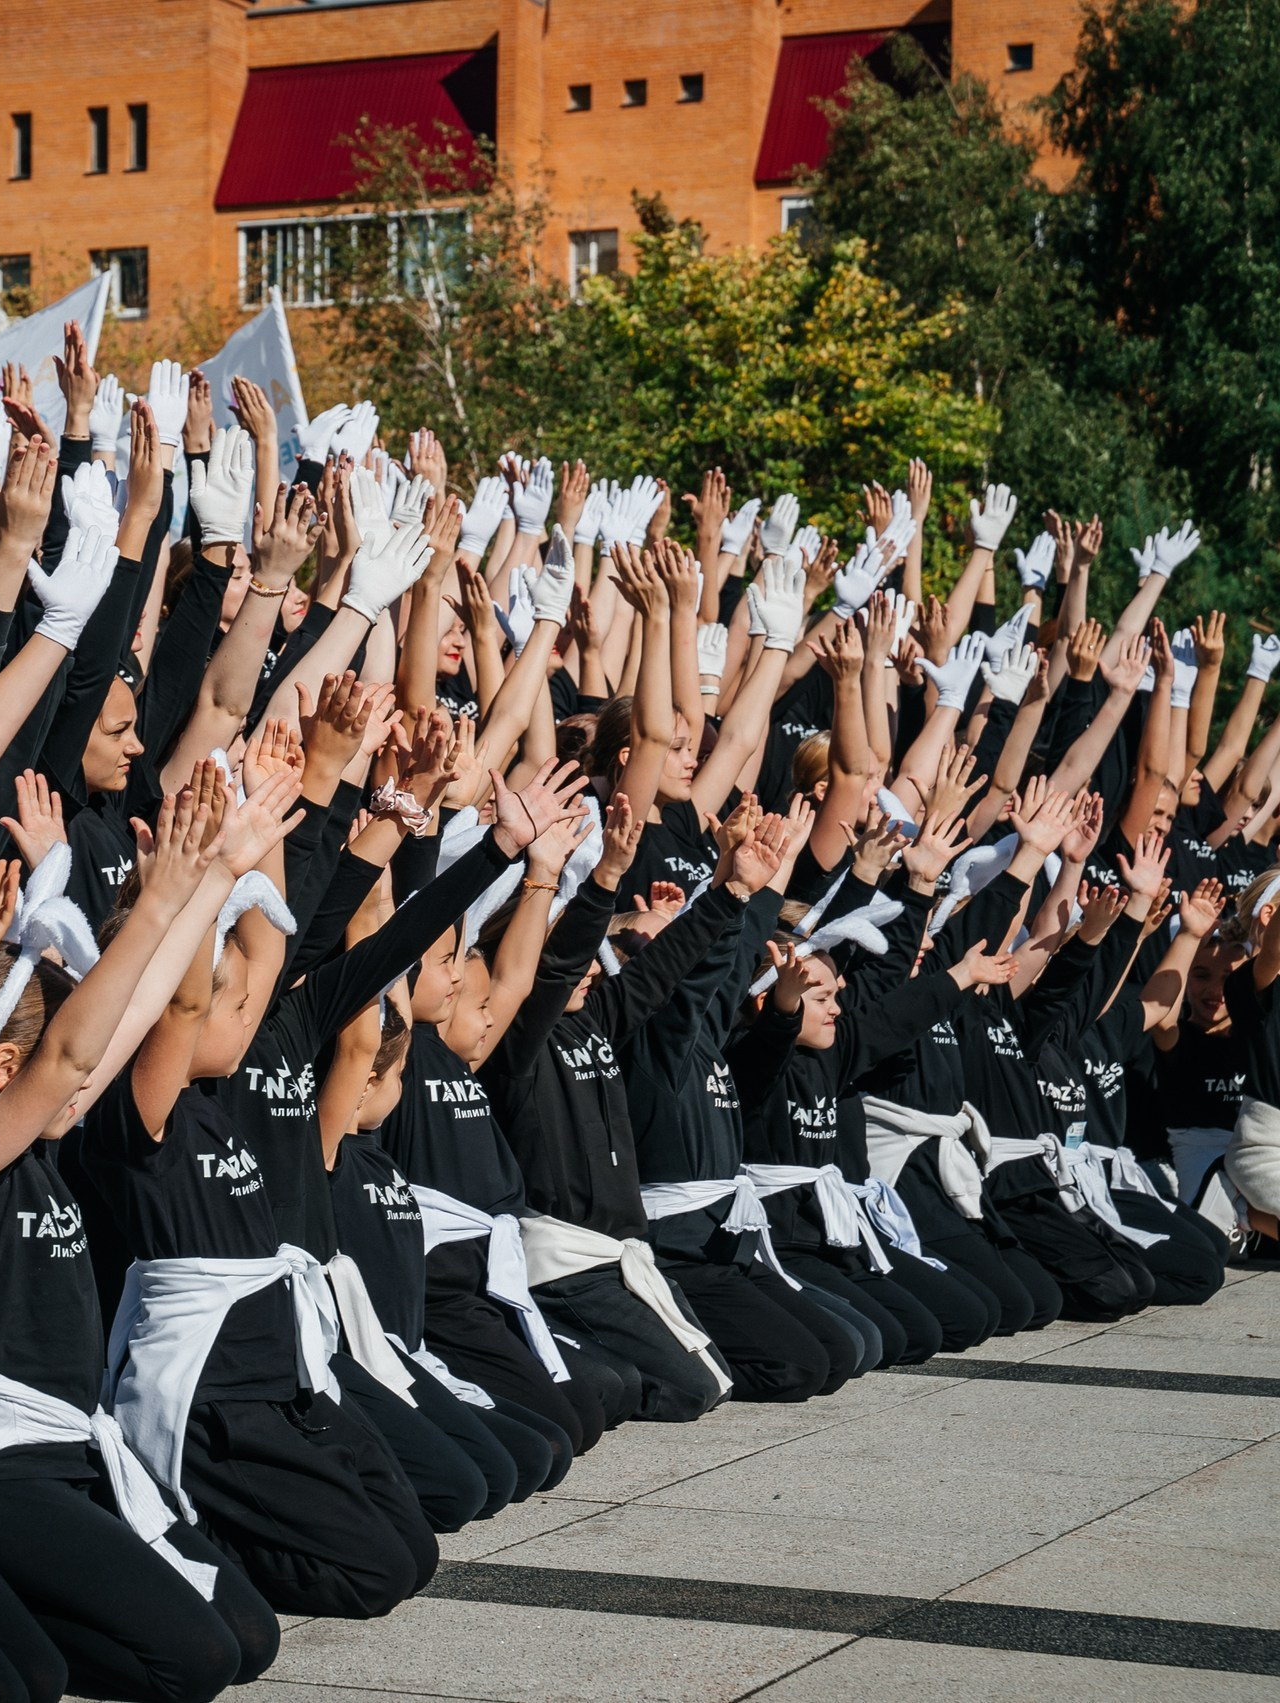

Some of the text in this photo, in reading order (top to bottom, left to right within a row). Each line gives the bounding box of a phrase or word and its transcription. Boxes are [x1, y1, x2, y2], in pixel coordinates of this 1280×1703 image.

[101, 866, 127, 885] TA
[424, 1079, 481, 1102] TANZ
[1204, 1079, 1241, 1092] TAN
[453, 1107, 485, 1119] Лилии
